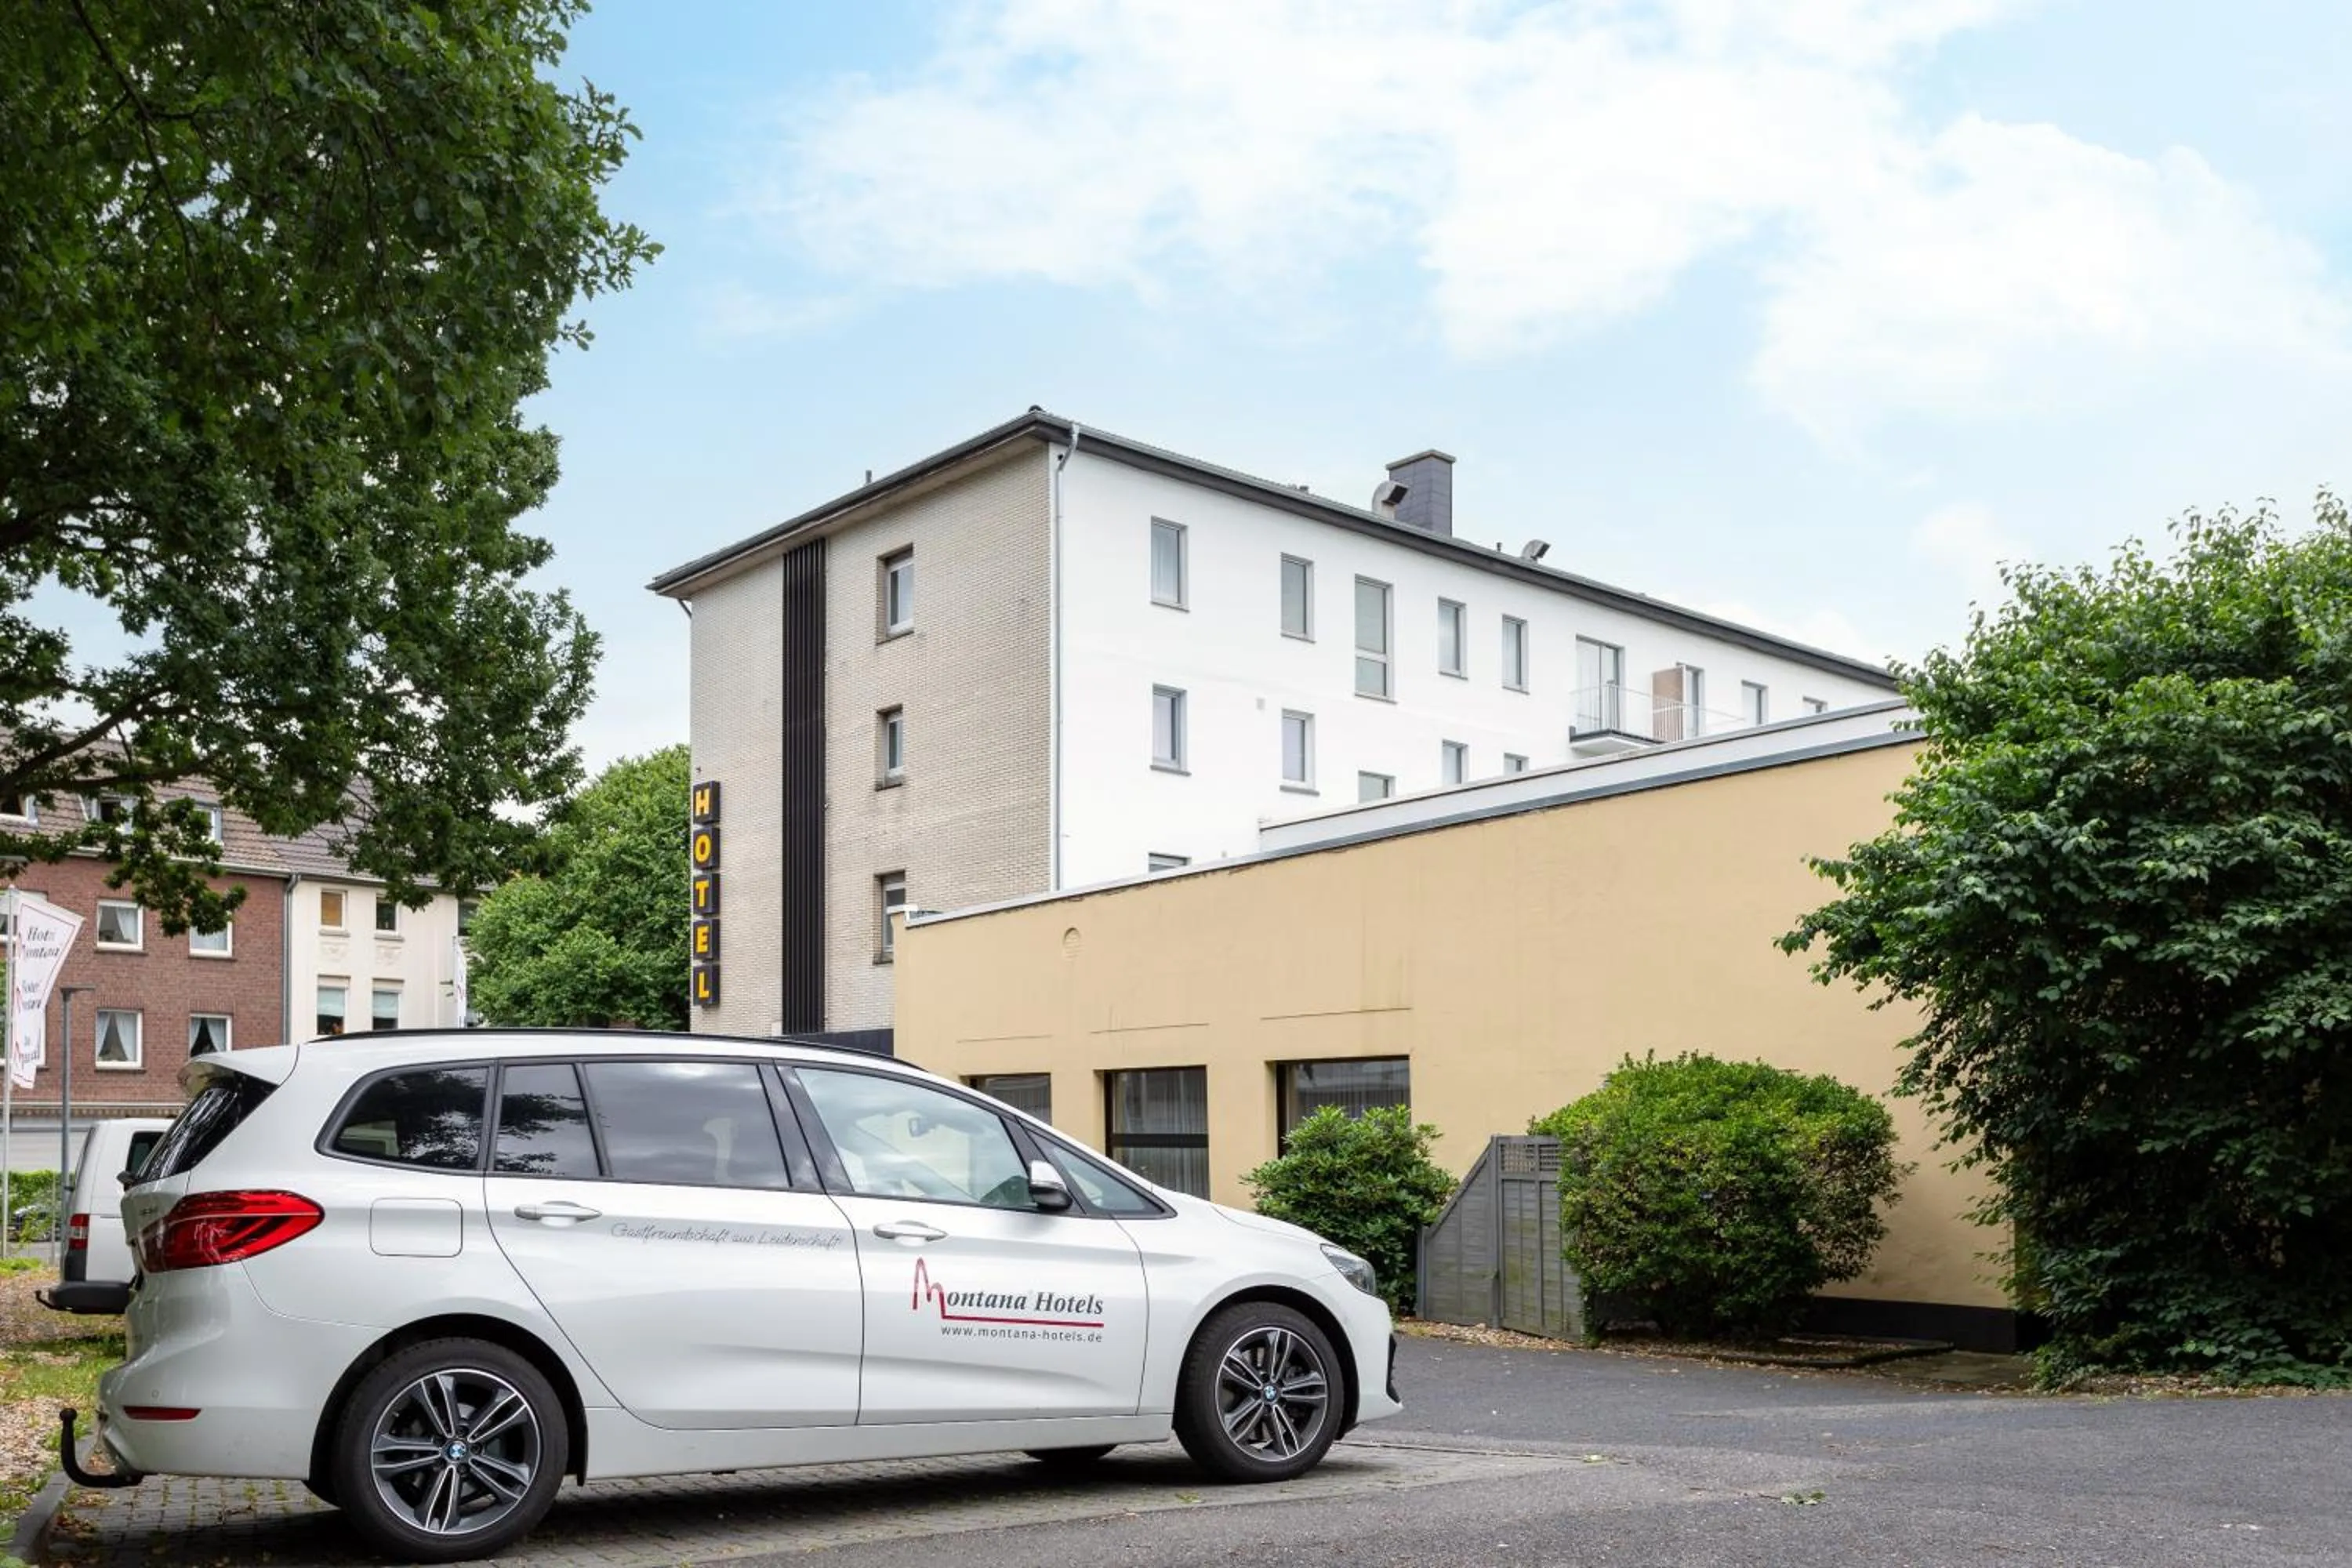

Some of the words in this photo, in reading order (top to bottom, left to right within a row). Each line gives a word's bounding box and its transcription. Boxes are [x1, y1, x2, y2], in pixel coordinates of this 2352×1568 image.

[695, 788, 711, 998] HOTEL
[611, 1221, 729, 1244] Gastfreundschaft
[731, 1233, 753, 1243] aus
[757, 1231, 844, 1250] Leidenschaft
[913, 1257, 1027, 1319] Montana
[1034, 1291, 1104, 1315] Hotels
[941, 1326, 1102, 1343] www.montana-hotels.de
